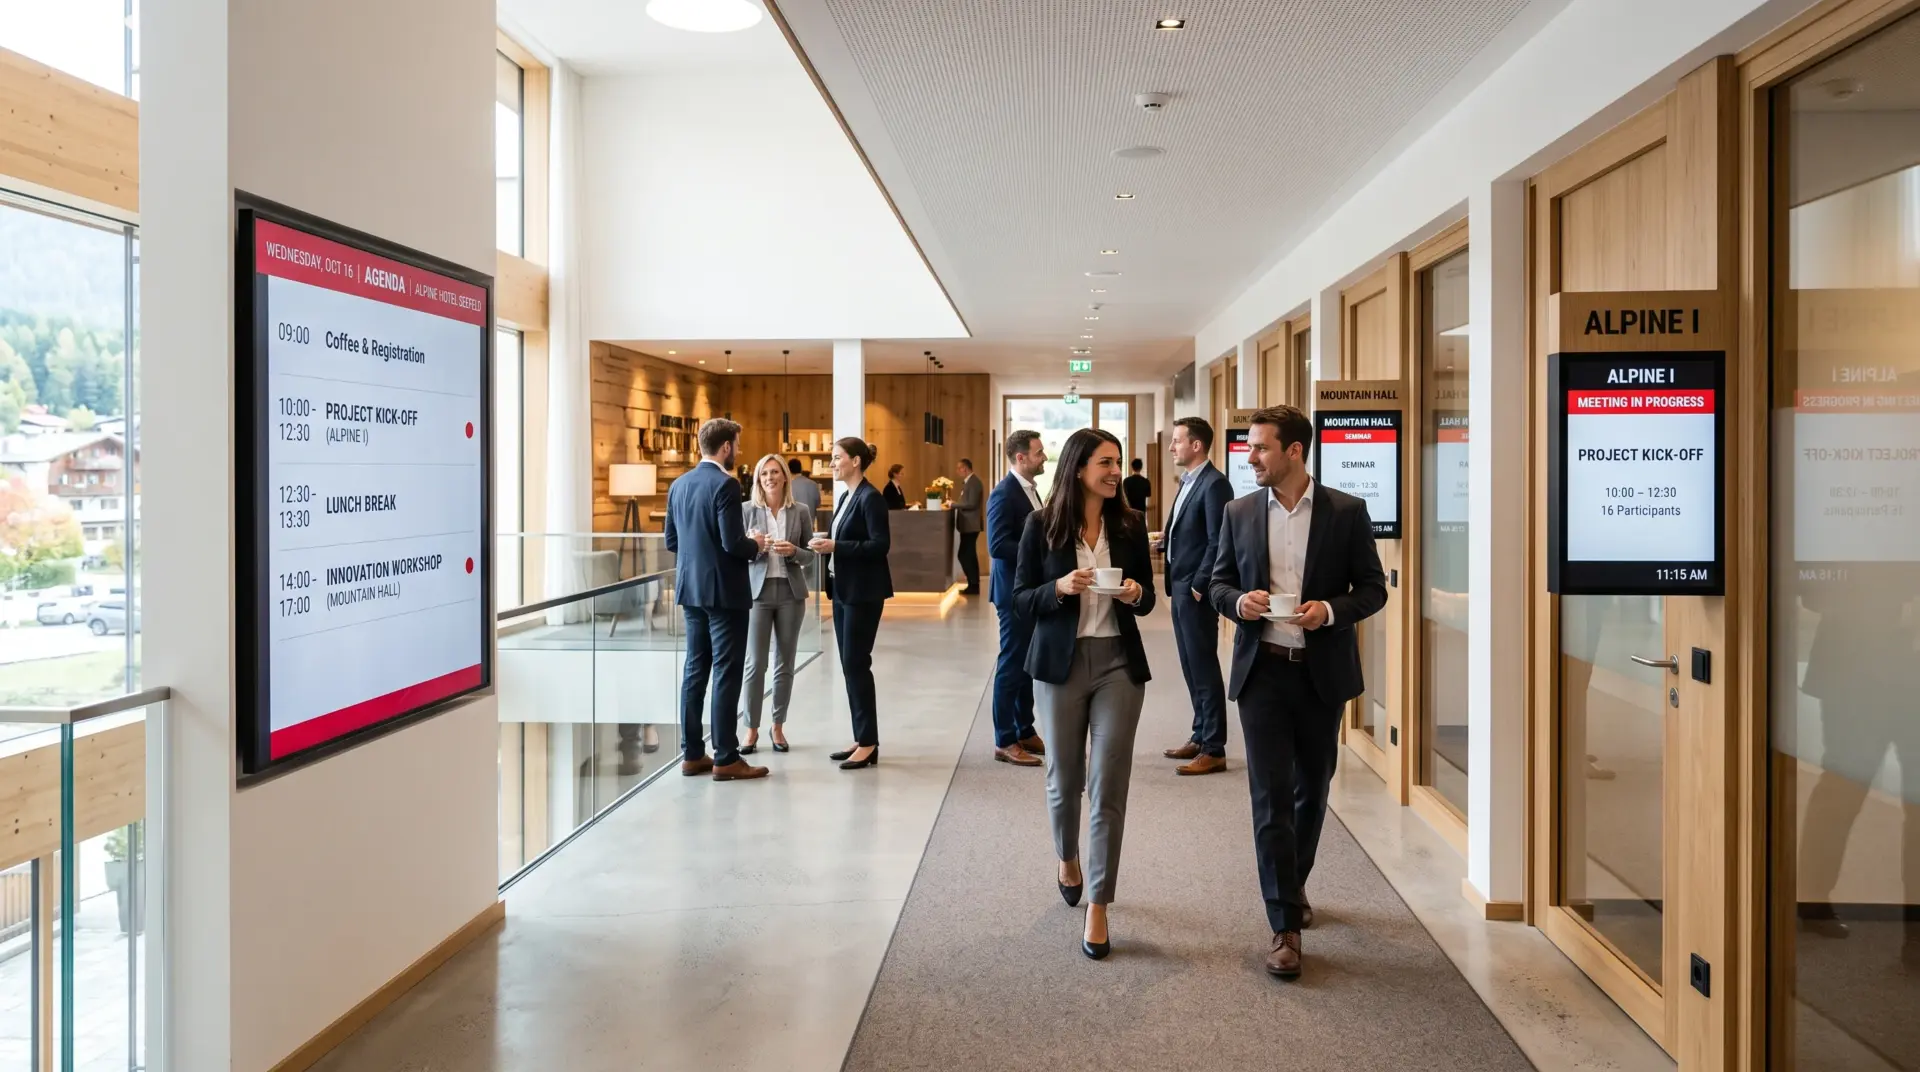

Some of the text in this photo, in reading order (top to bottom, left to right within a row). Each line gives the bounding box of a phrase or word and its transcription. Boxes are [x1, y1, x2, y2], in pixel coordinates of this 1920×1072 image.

[266, 241, 323, 273] WEDNESDAY,
[325, 257, 342, 275] OCT
[344, 263, 353, 278] 16
[364, 266, 406, 294] AGENDA
[414, 283, 438, 299] ALPINE
[438, 289, 458, 306] HOTEL
[1584, 309, 1699, 335] ALPINE I
[278, 322, 310, 345] 09:00
[325, 330, 425, 364] Coffee & Registration
[1607, 368, 1675, 384] ALPINE I
[1320, 390, 1398, 400] MOUNTAIN HALL
[1577, 396, 1705, 409] MEETING IN PROGRESS
[325, 402, 418, 426] PROJECT KICK-OFF
[1324, 418, 1393, 427] MOUNTAIN HALL
[279, 423, 310, 442] 12:30
[326, 426, 369, 446] (ALPINE I)
[1578, 448, 1704, 462] PROJECT KICK-OFF
[1340, 481, 1356, 489] 10:00
[1362, 481, 1378, 489] 12:30
[1605, 487, 1635, 499] 10:00
[1648, 487, 1677, 499] 12:30
[326, 494, 396, 514] LUNCH BREAK
[1601, 504, 1681, 518] 16 Participants
[279, 509, 310, 529] 13:30
[326, 554, 442, 586] INNOVATION WORKSHOP
[1656, 569, 1708, 580] 11:15 AM
[326, 581, 401, 611] (MOUNTAIN HALL)
[279, 595, 310, 618] 17:00
